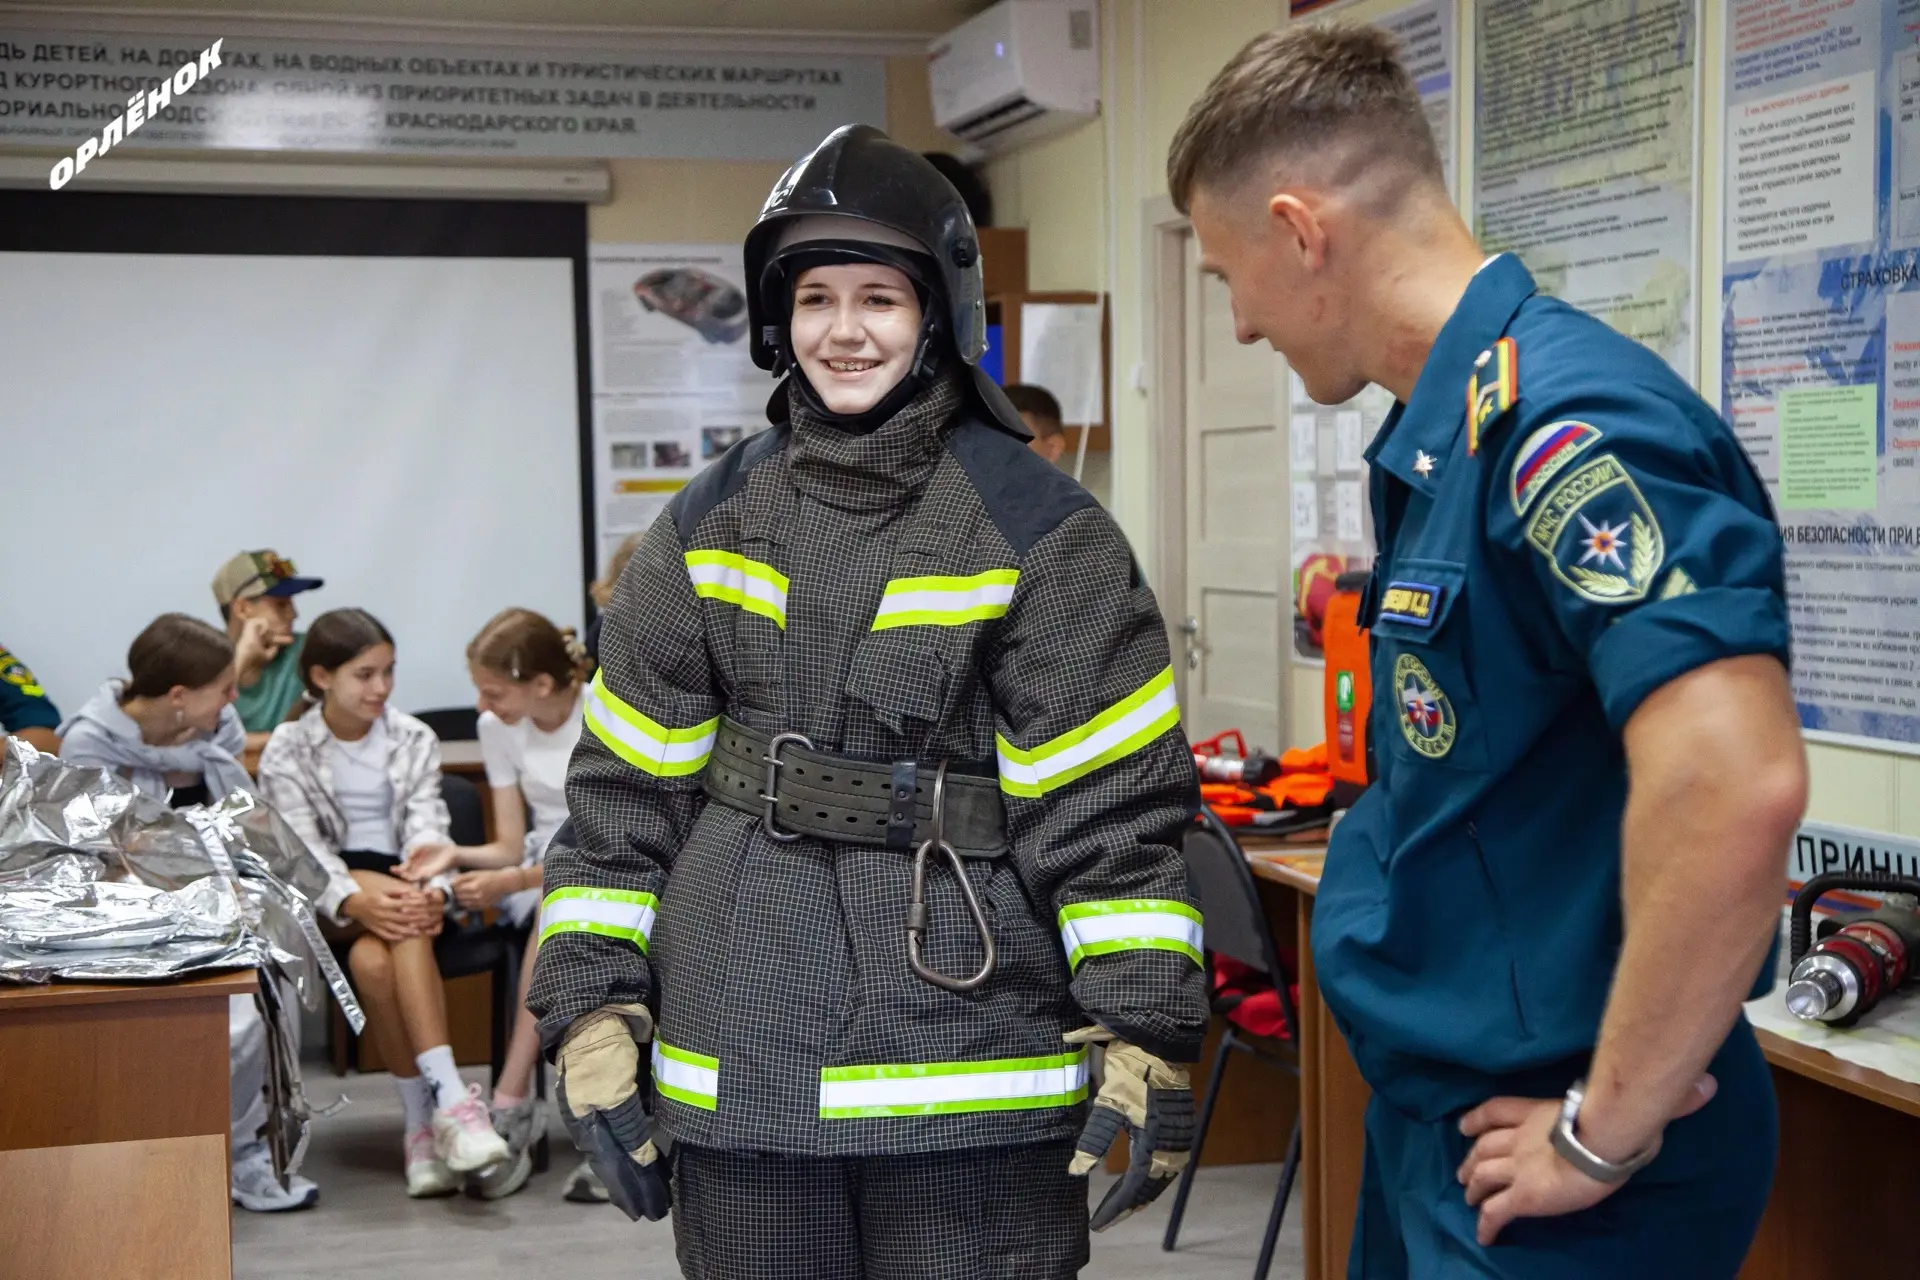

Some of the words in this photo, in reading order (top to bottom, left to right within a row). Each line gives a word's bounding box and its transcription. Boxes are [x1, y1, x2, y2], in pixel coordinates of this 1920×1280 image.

[120, 48, 153, 64] НА
[272, 53, 304, 70] НА
[309, 54, 402, 74] ВОДНЫХ
[408, 57, 518, 78] ОБЪЕКТАХ
[526, 61, 541, 78] И
[546, 61, 714, 83] ТУРИСТИЧЕСКИХ
[721, 66, 842, 86] МАРШРУТАХ
[388, 84, 562, 106] ПРИОРИТЕТНЫХ
[566, 89, 635, 109] ЗАДАЧ
[639, 92, 651, 108] В
[657, 92, 817, 112] ДЕЯТЕЛЬНОСТИ
[0, 99, 135, 121] ОРИАЛЬНО
[385, 111, 578, 134] КРАСНОДАРСКОГО
[1841, 263, 1919, 291] СТРАХОВКА
[1534, 507, 1561, 541] МЧС
[1556, 463, 1616, 511] РОССИИ
[1797, 525, 1886, 545] БЕЗОПАСНОСТИ
[1889, 527, 1913, 546] ПРИ
